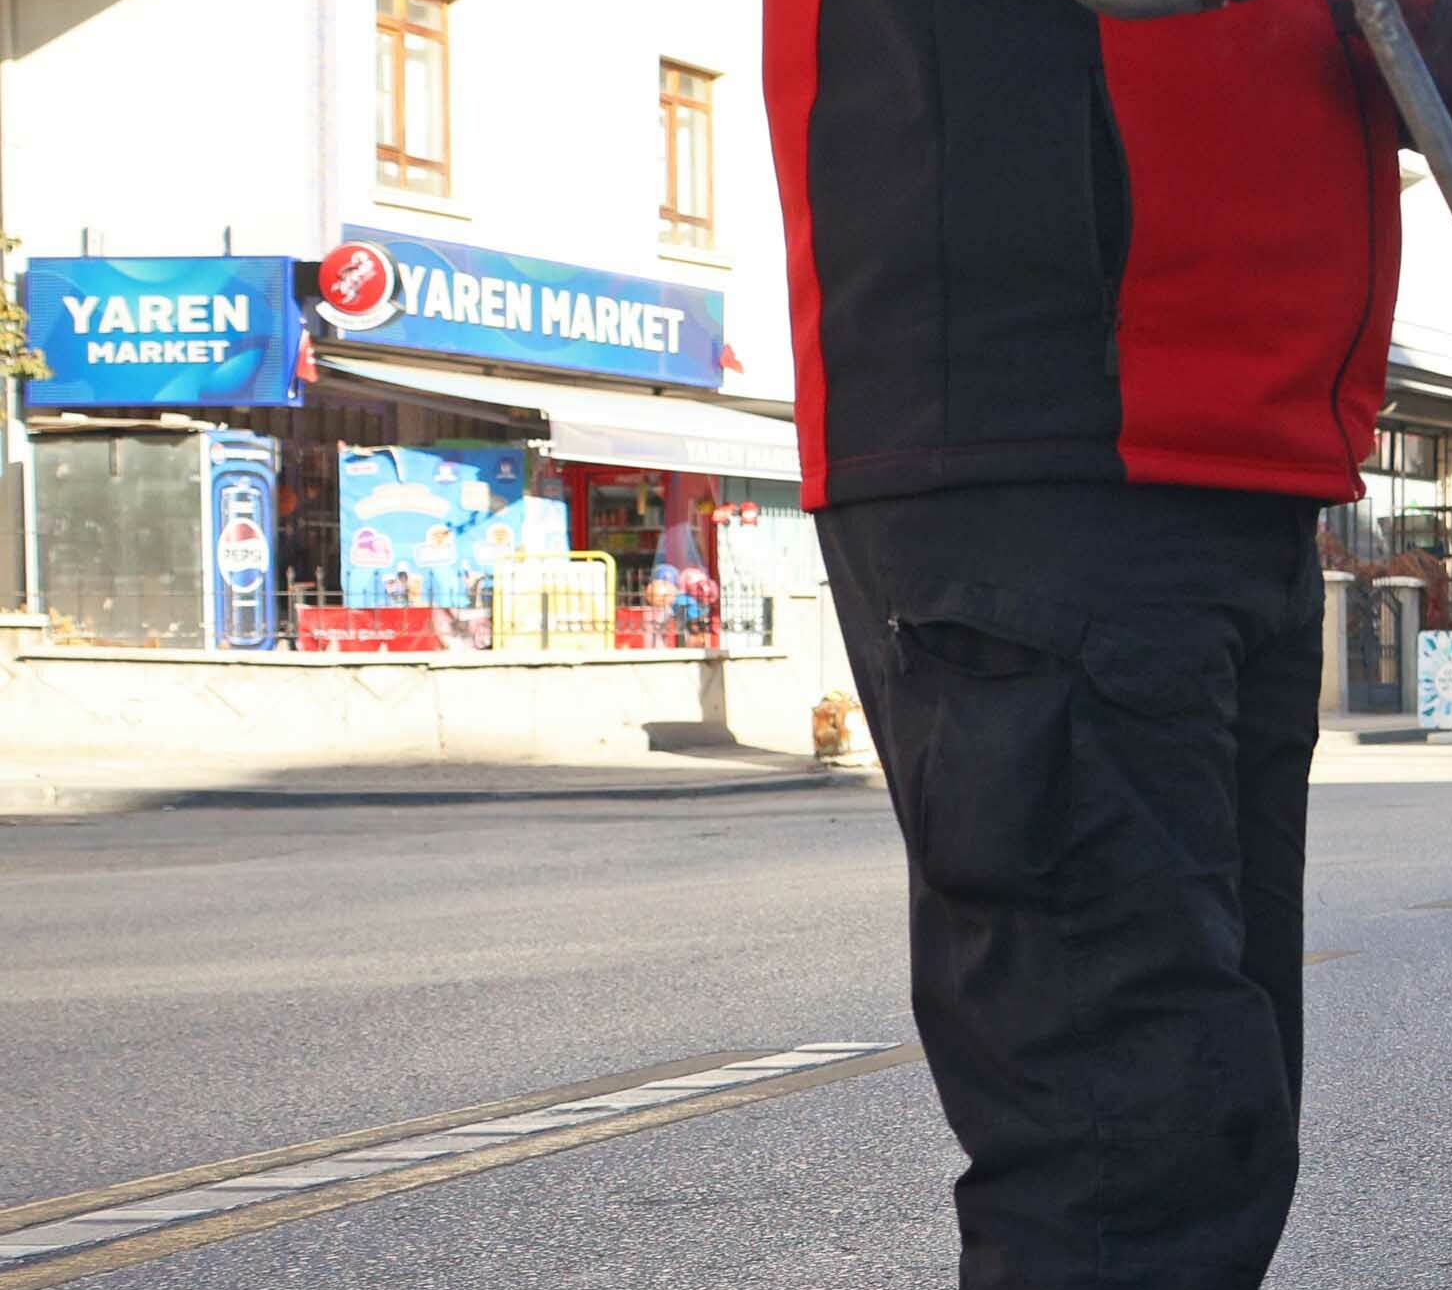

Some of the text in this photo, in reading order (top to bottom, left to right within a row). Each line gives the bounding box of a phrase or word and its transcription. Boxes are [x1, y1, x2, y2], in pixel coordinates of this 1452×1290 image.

[62, 294, 249, 334] YAREN
[399, 262, 685, 355] YAREN MARKET
[87, 339, 230, 364] MARKET
